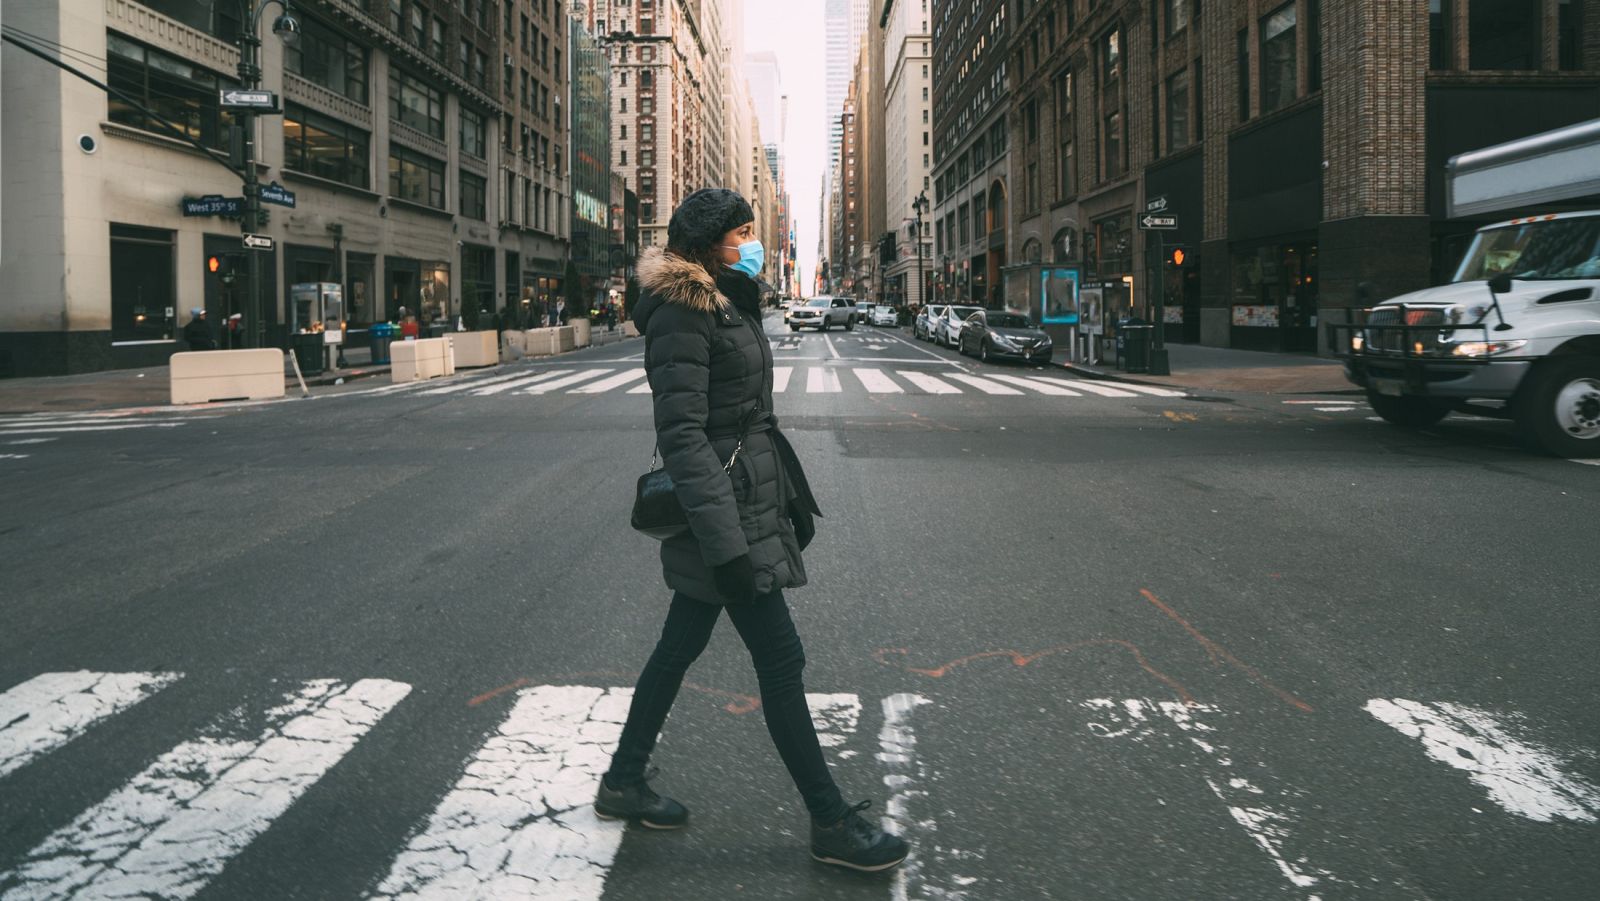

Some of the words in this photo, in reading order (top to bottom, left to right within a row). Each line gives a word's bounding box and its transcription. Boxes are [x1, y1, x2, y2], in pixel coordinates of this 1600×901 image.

[261, 188, 283, 201] Seventh
[283, 195, 294, 204] Ave
[188, 203, 209, 212] West
[227, 202, 237, 211] St
